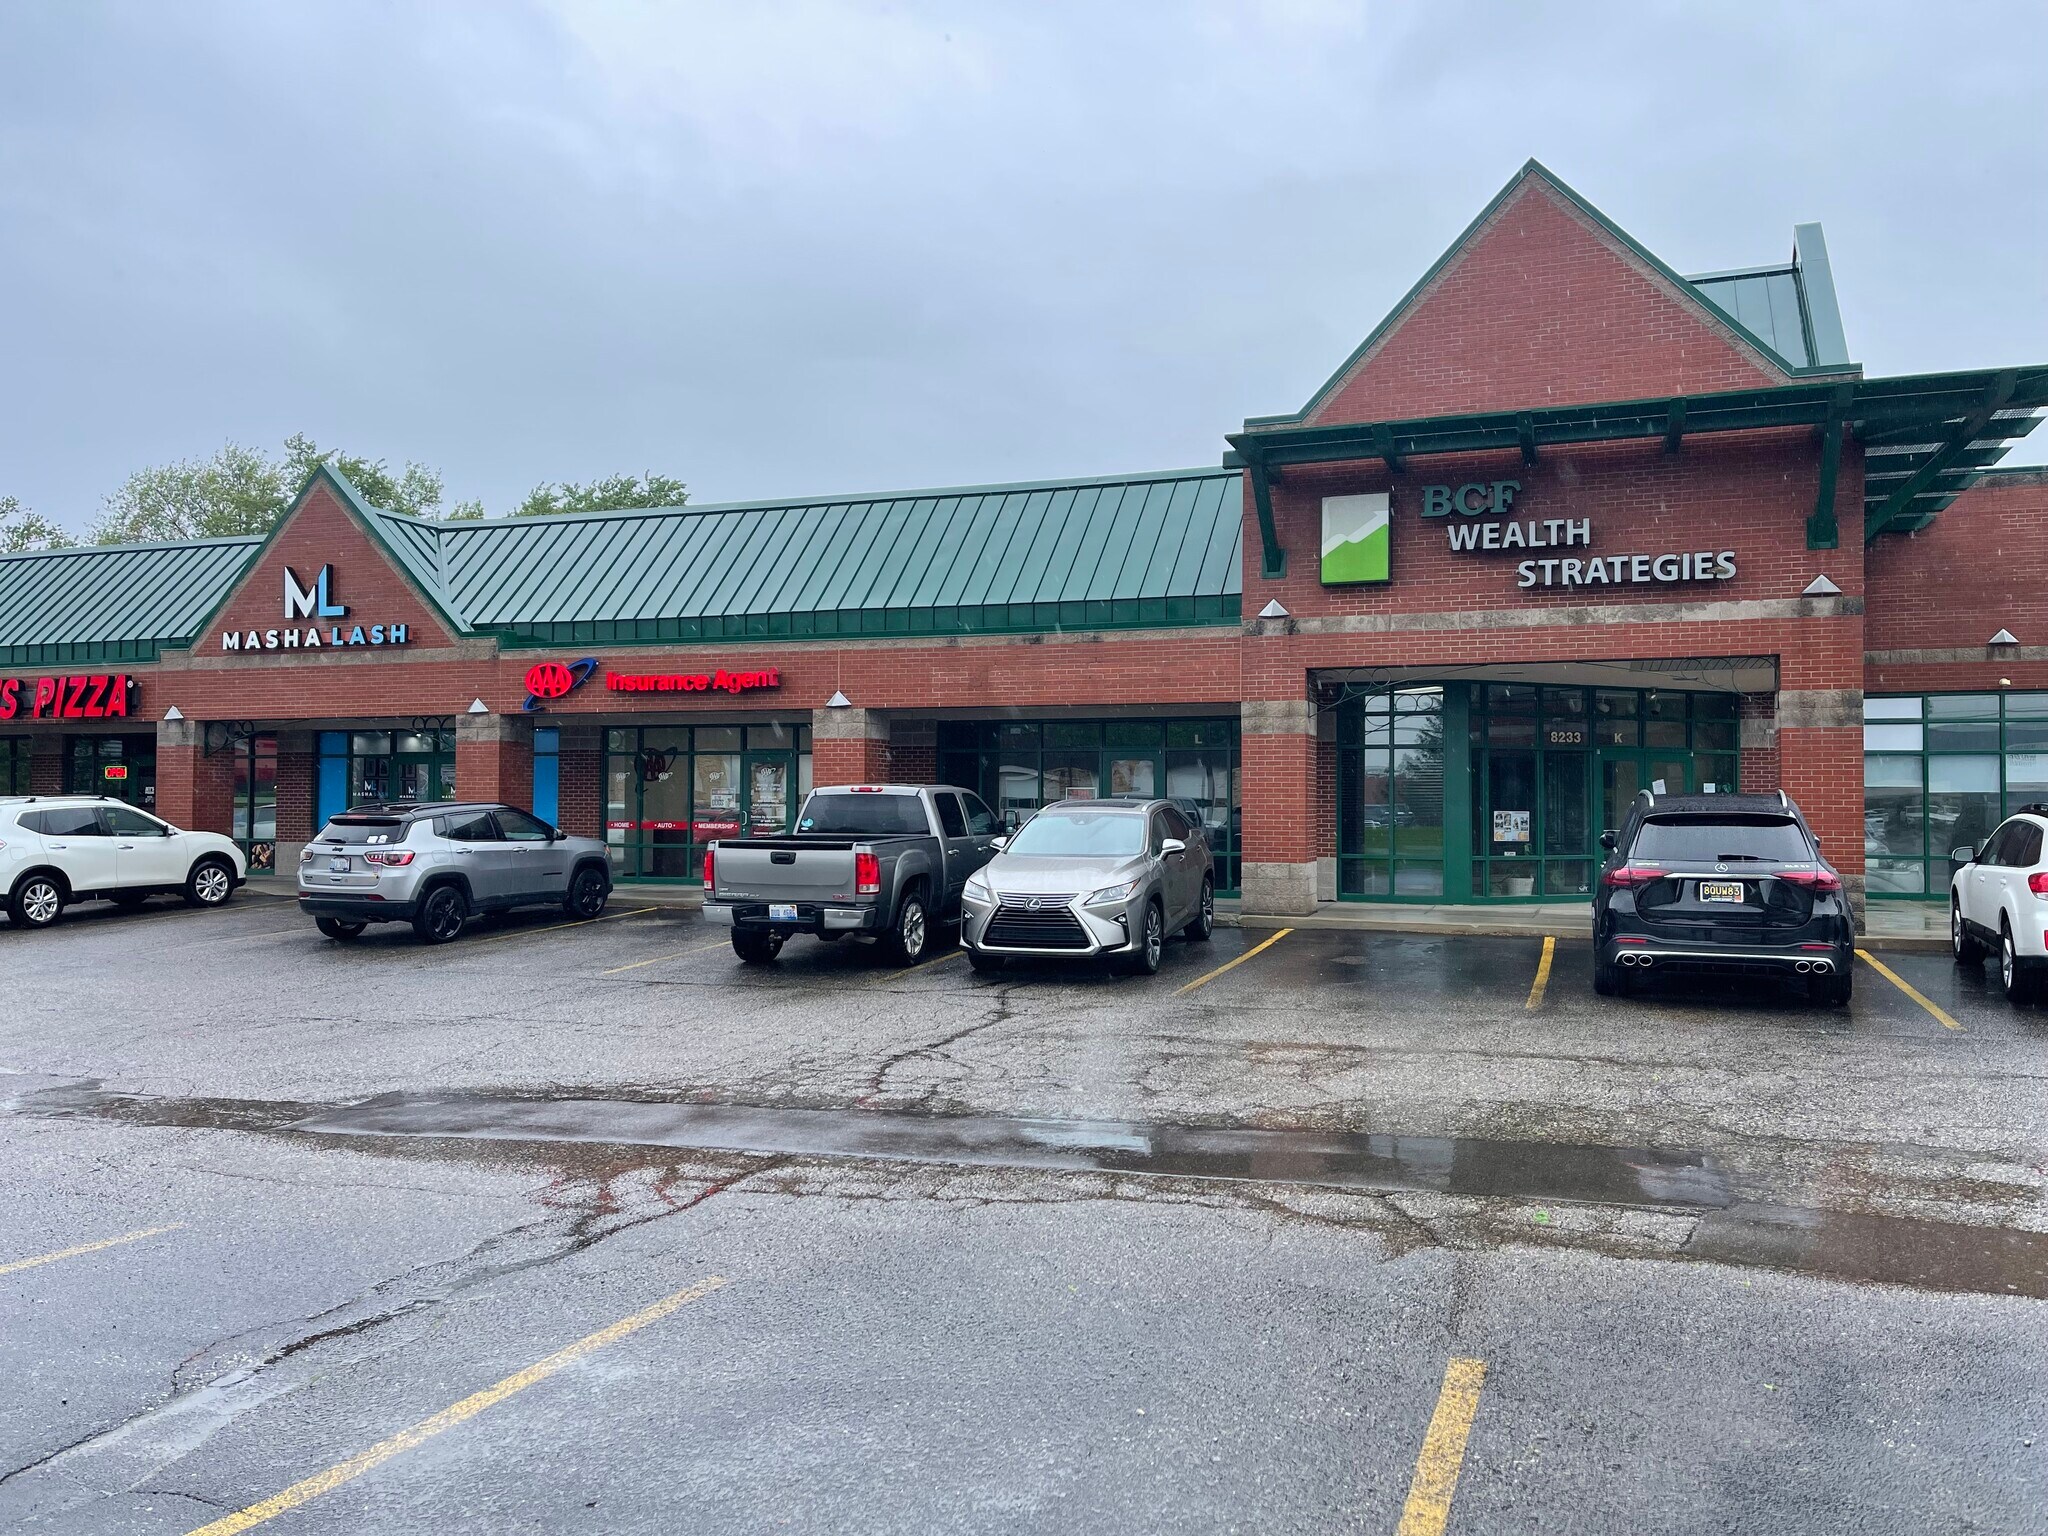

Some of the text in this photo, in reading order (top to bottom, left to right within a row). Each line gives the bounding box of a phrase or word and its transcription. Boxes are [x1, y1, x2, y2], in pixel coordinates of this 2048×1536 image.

[1420, 480, 1521, 518] BCF
[1447, 518, 1590, 551] WEALTH
[1516, 551, 1737, 588] STRATEGIES
[222, 624, 406, 650] MASHA LASH
[529, 666, 570, 697] AAA
[606, 667, 779, 693] Insurance Agent
[1194, 734, 1202, 744] L
[1551, 731, 1582, 743] 8233
[1614, 733, 1623, 743] K
[106, 767, 126, 778] OPEN
